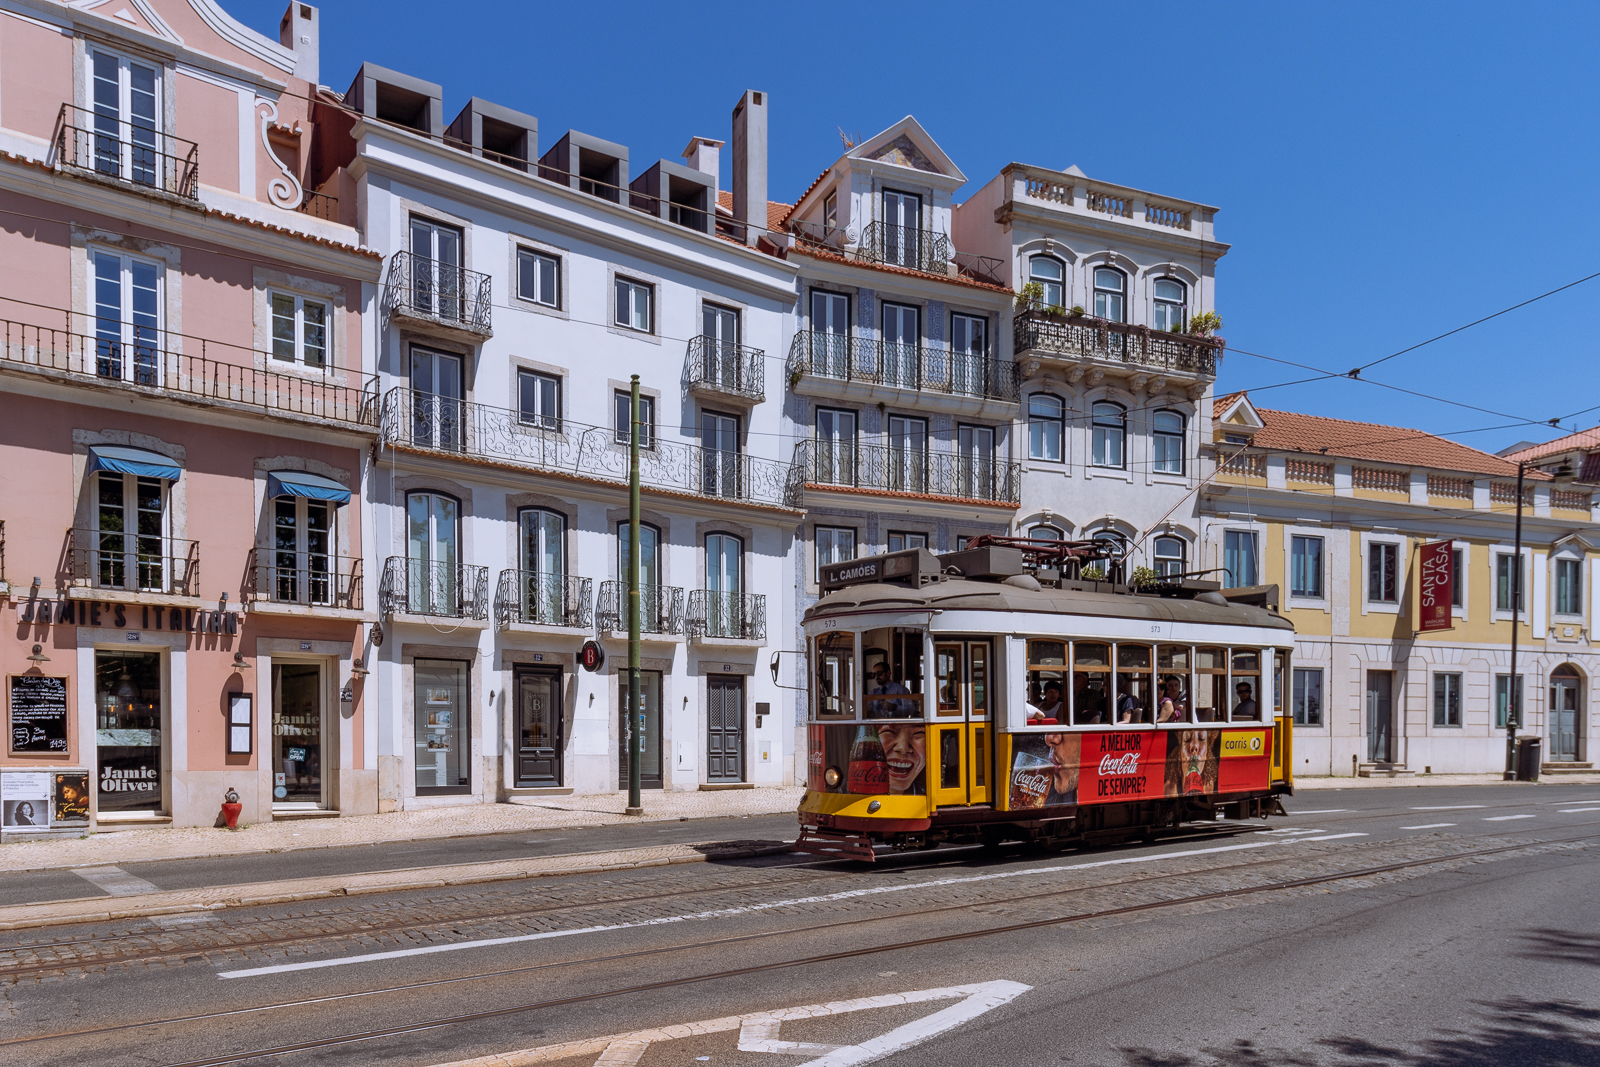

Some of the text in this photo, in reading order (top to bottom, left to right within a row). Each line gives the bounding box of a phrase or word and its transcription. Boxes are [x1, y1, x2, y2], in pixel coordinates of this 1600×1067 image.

[1436, 543, 1448, 584] CASA
[830, 572, 838, 582] L.
[1422, 558, 1434, 606] SANTA
[143, 606, 236, 634] ITALIAN
[825, 620, 836, 628] 573
[587, 649, 594, 664] B
[532, 698, 540, 710] B
[272, 712, 320, 724] Jamie
[272, 724, 320, 736] Oliver
[1100, 734, 1142, 752] A MELHOR
[1225, 736, 1247, 750] carris
[1098, 752, 1141, 776] Coca-Cola
[101, 766, 157, 779] Jamie
[102, 779, 158, 792] Oliver
[1014, 769, 1050, 794] Coca-Cola
[1098, 776, 1146, 796] DE SEMPRE?
